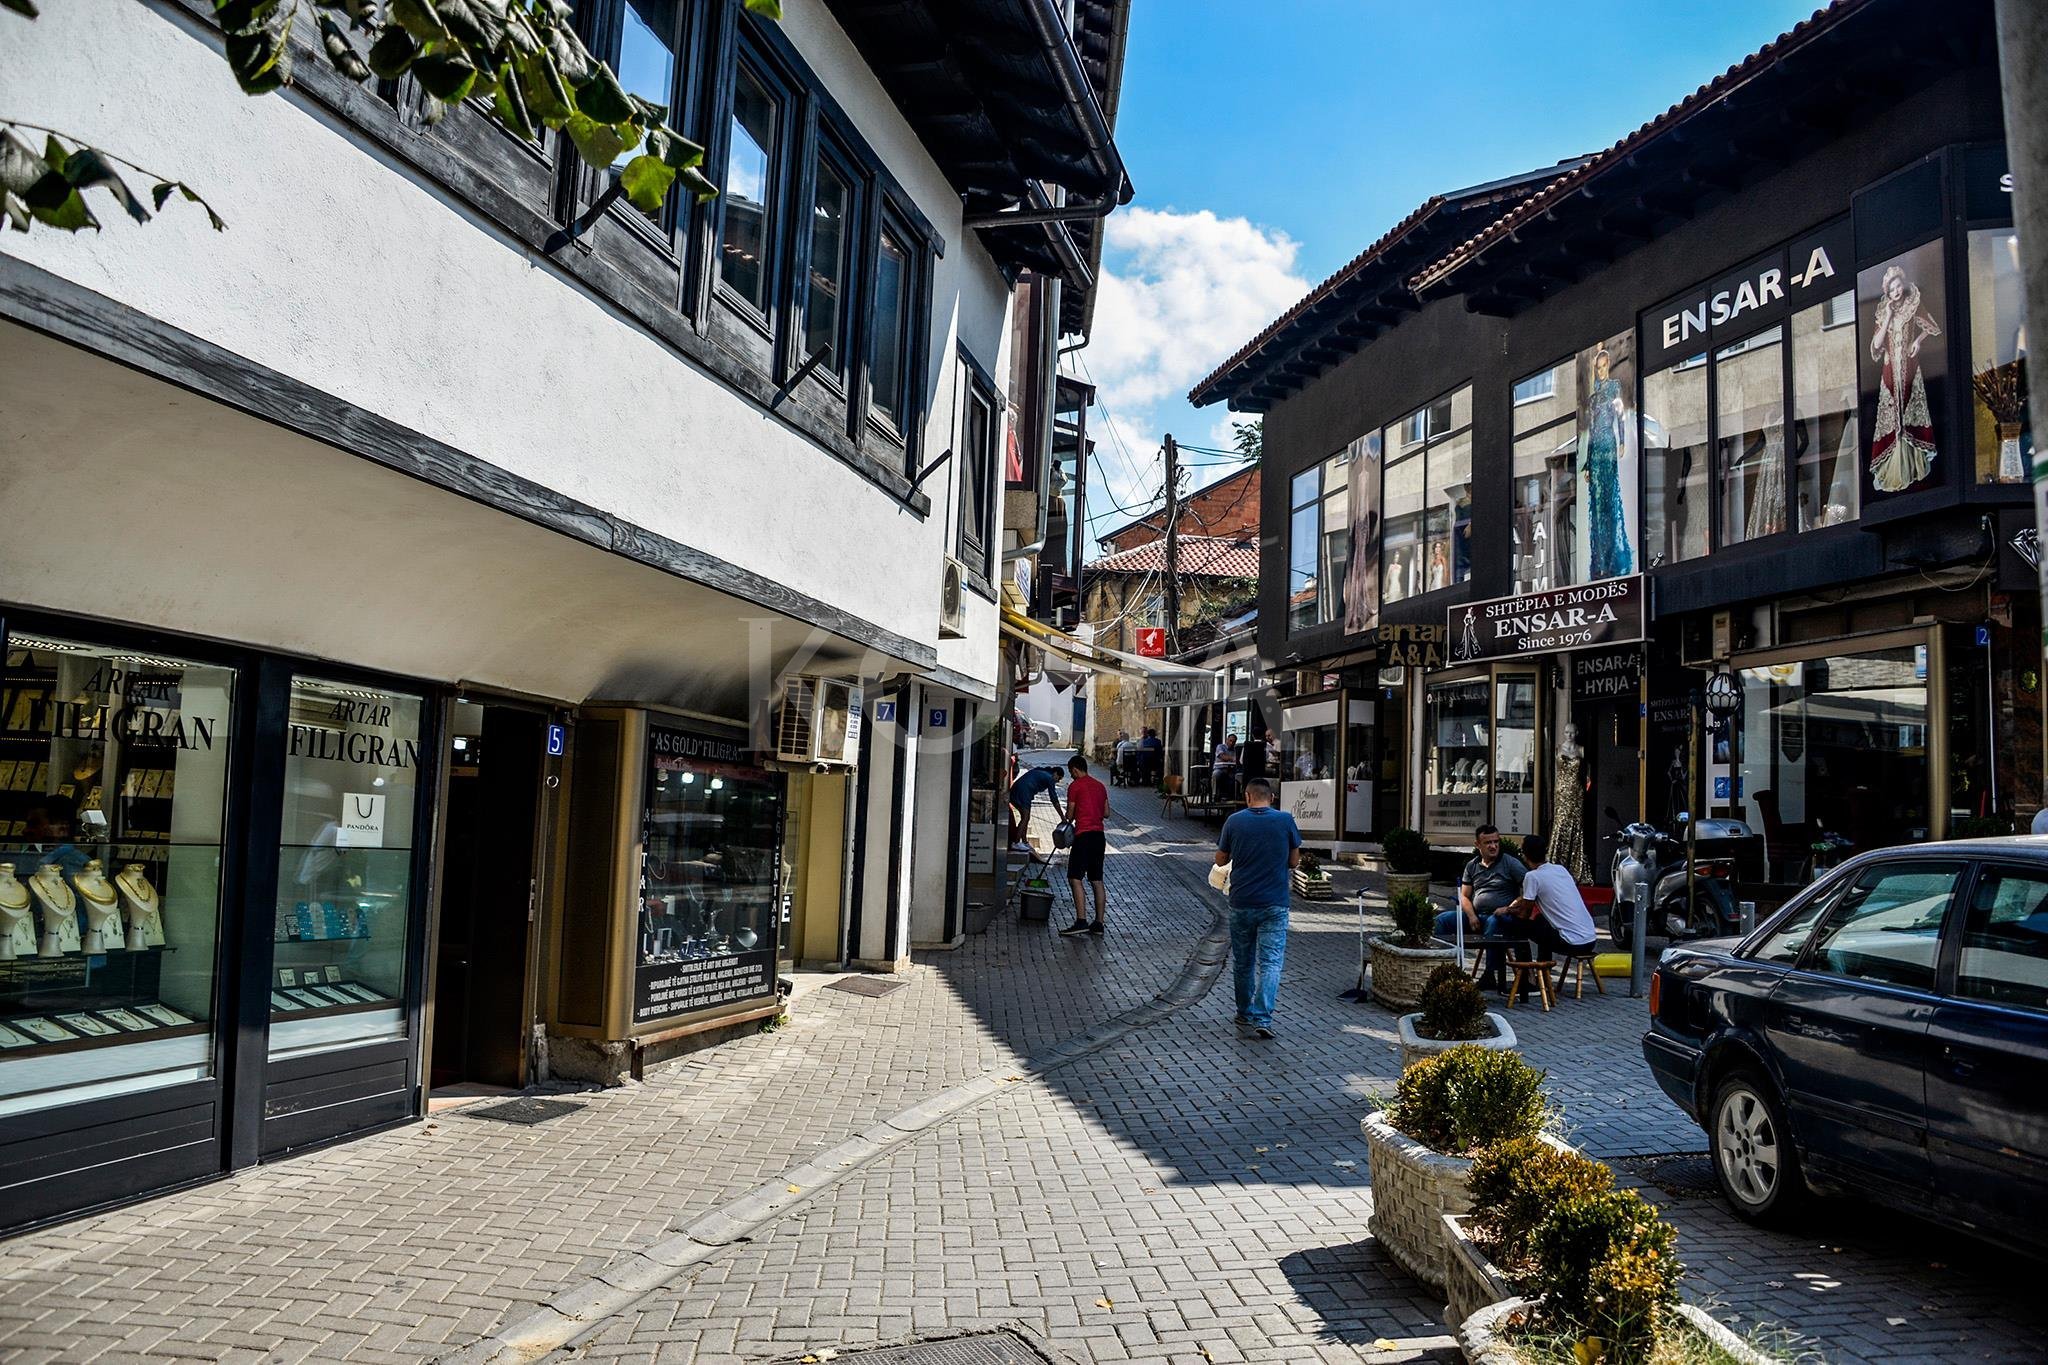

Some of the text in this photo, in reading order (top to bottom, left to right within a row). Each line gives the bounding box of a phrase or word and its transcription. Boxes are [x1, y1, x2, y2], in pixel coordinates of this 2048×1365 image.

[1662, 246, 1835, 350] ENSAR-A
[1485, 582, 1628, 618] SHTËPIA E MODËS
[1378, 623, 1446, 643] artar
[1494, 602, 1618, 639] ENSAR-A
[1518, 629, 1592, 650] Since 1976
[1980, 628, 1988, 644] 2
[1585, 675, 1630, 695] HYRJA
[29, 698, 216, 752] FILIGRAN
[329, 699, 392, 728] ARTAR
[934, 711, 944, 725] 9
[288, 726, 421, 769] FILIGRAN
[551, 729, 561, 752] 5
[638, 808, 651, 913] ARTAR
